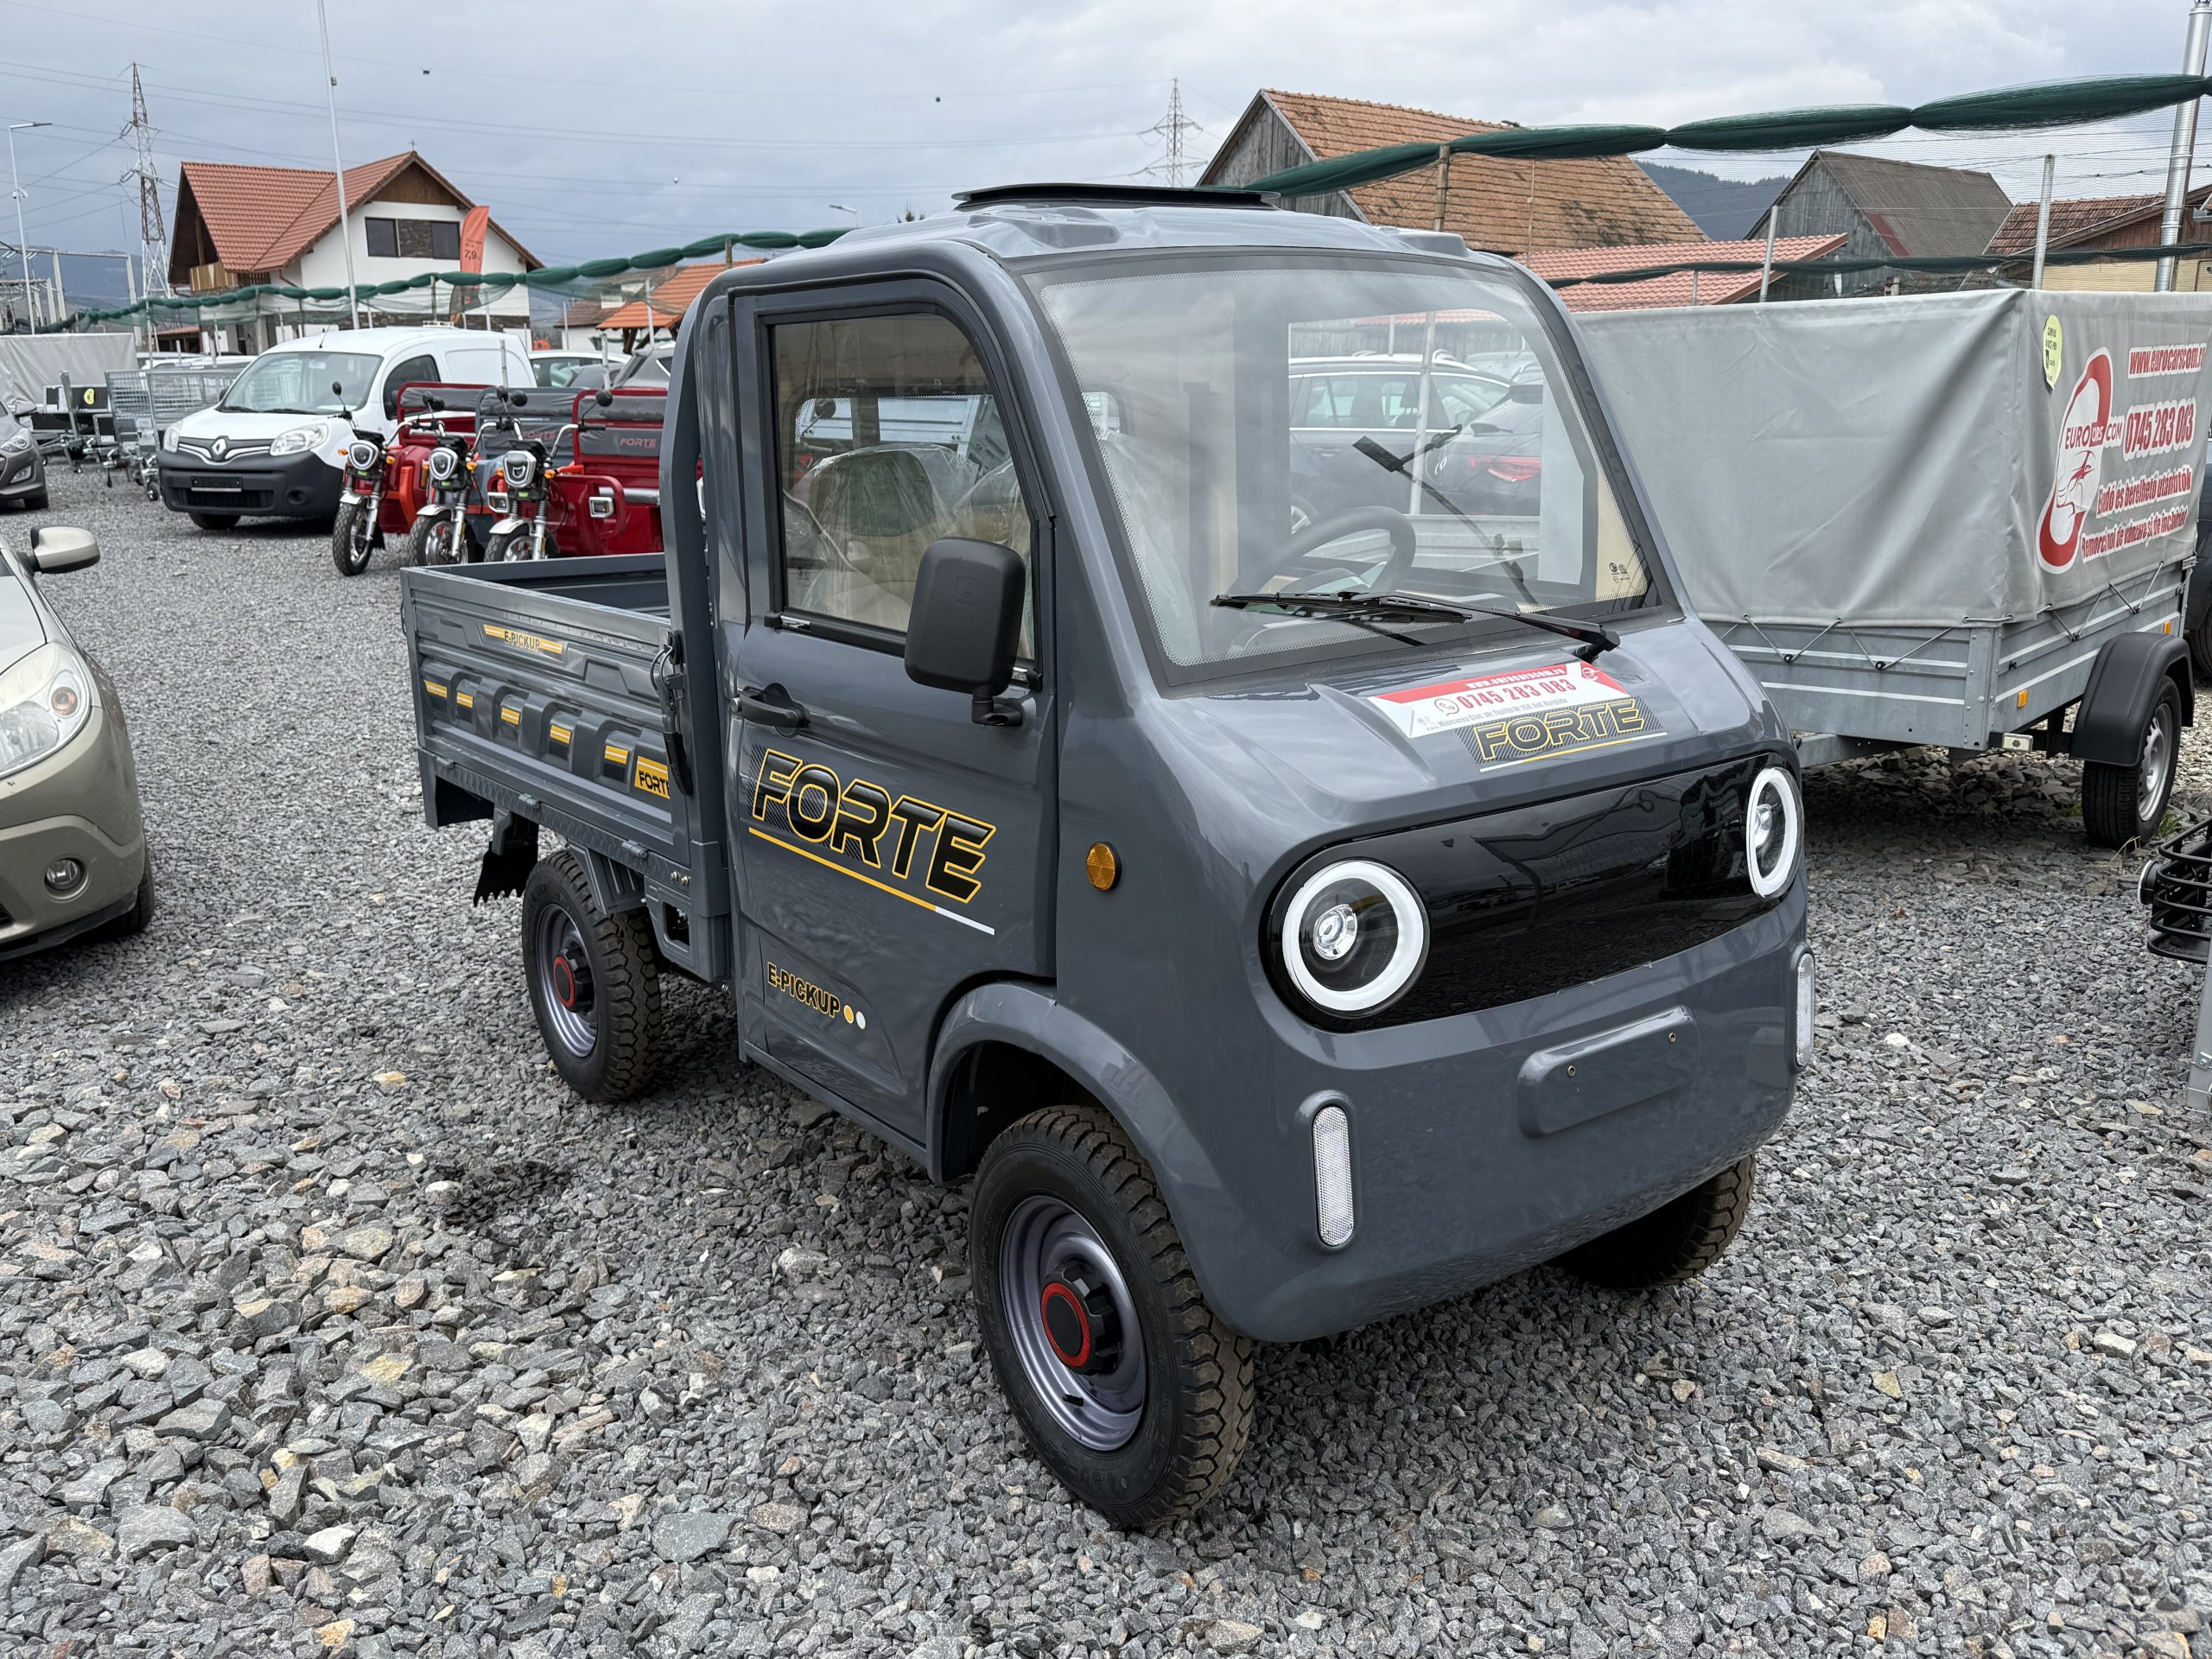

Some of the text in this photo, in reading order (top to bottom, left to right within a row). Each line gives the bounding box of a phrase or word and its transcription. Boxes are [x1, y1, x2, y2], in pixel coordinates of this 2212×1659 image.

[620, 437, 657, 448] FORTE
[2125, 404, 2194, 454] 0745 283 083
[504, 630, 540, 652] E-PICKUP
[1457, 678, 1577, 709] 0745 283 083
[1473, 698, 1643, 761] FORTE
[753, 748, 996, 904] FORTE
[766, 961, 841, 1019] E-PICKUP
